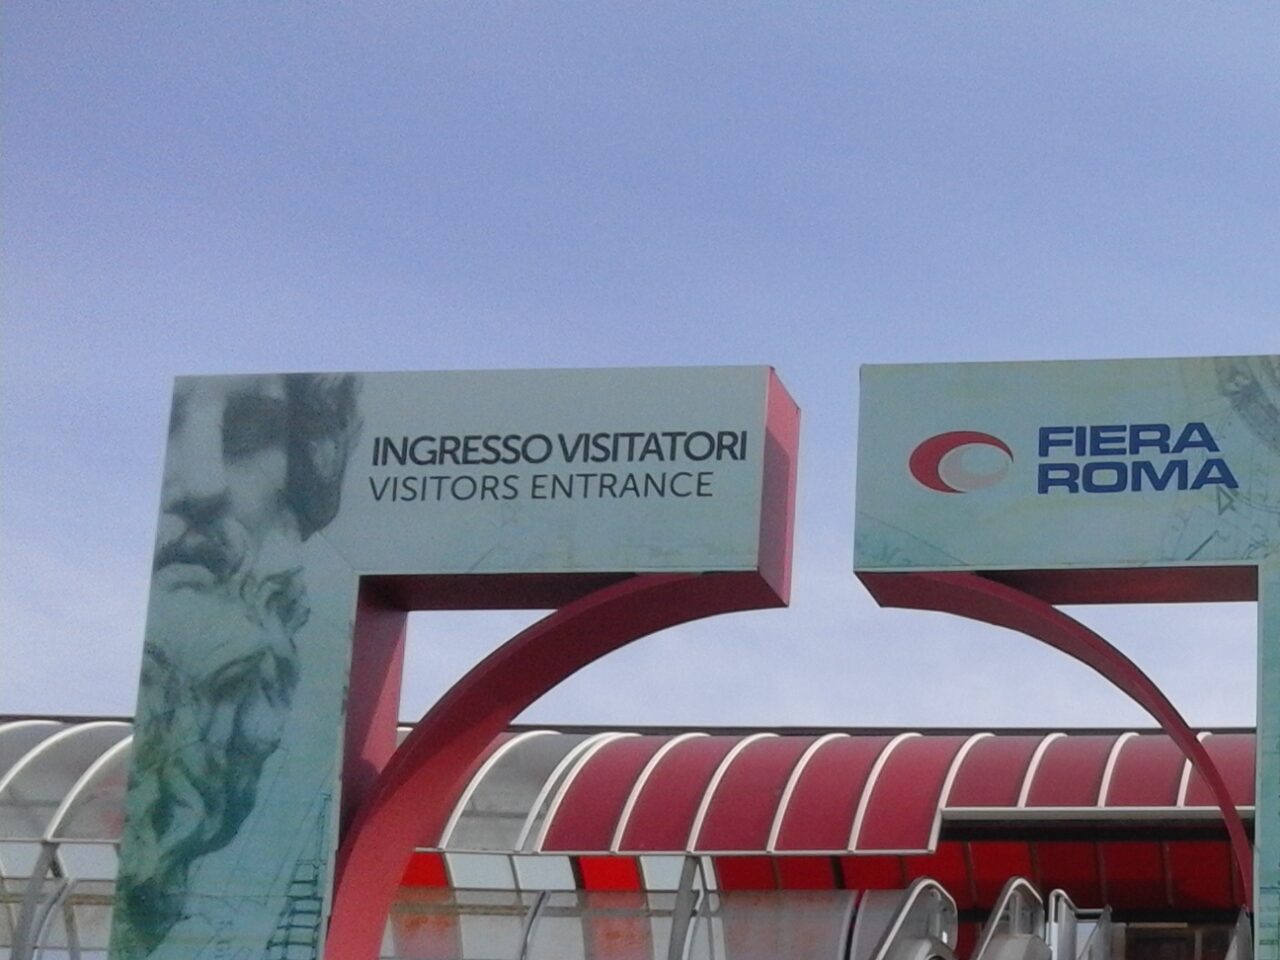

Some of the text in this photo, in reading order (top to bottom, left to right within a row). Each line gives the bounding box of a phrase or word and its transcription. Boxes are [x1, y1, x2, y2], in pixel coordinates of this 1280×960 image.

[371, 430, 748, 467] INGRESSO VISITATORI
[1038, 422, 1221, 458] FIERA
[369, 471, 715, 502] VISITORS ENTRANCE
[1037, 458, 1240, 494] ROMA
